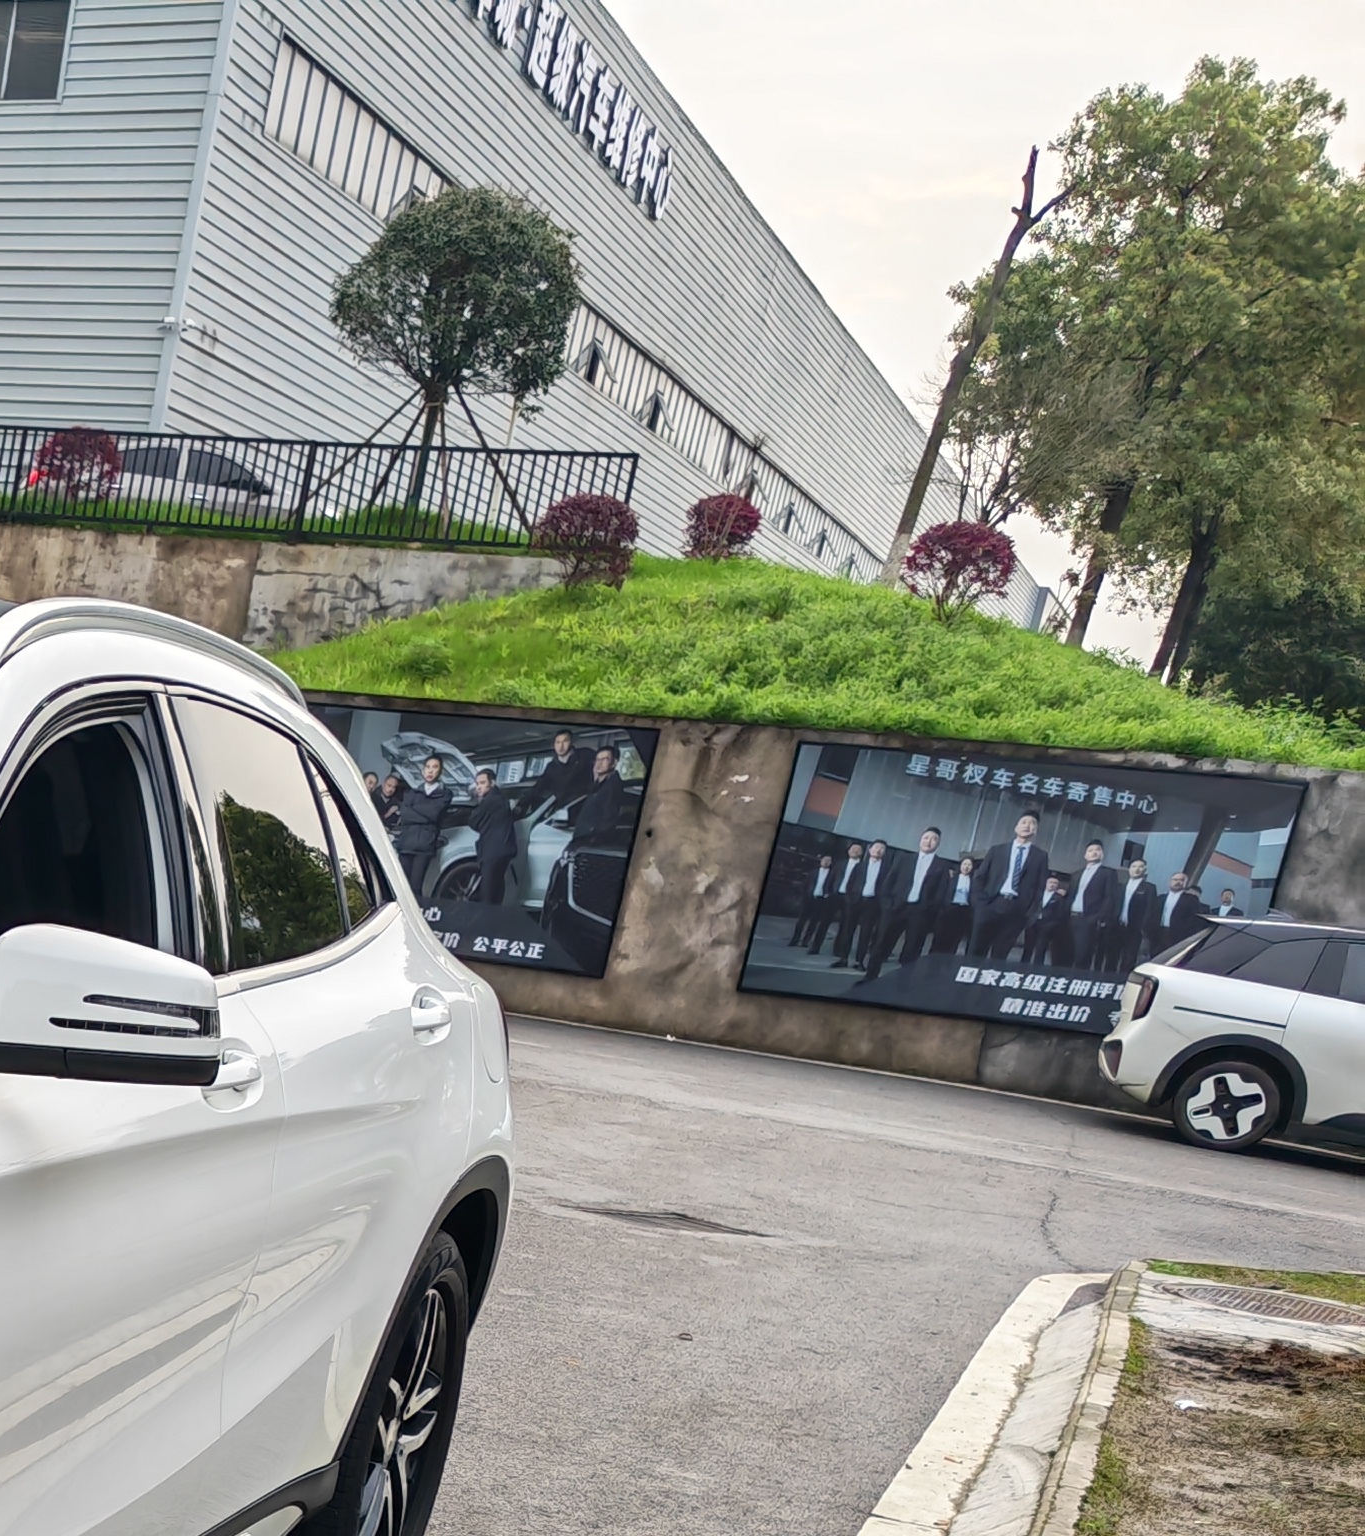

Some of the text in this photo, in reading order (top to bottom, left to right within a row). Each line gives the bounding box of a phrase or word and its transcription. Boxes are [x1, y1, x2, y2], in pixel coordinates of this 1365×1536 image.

[419, 906, 442, 922] 心
[472, 936, 546, 960] 公平公正
[999, 997, 1092, 1023] 精准出价
